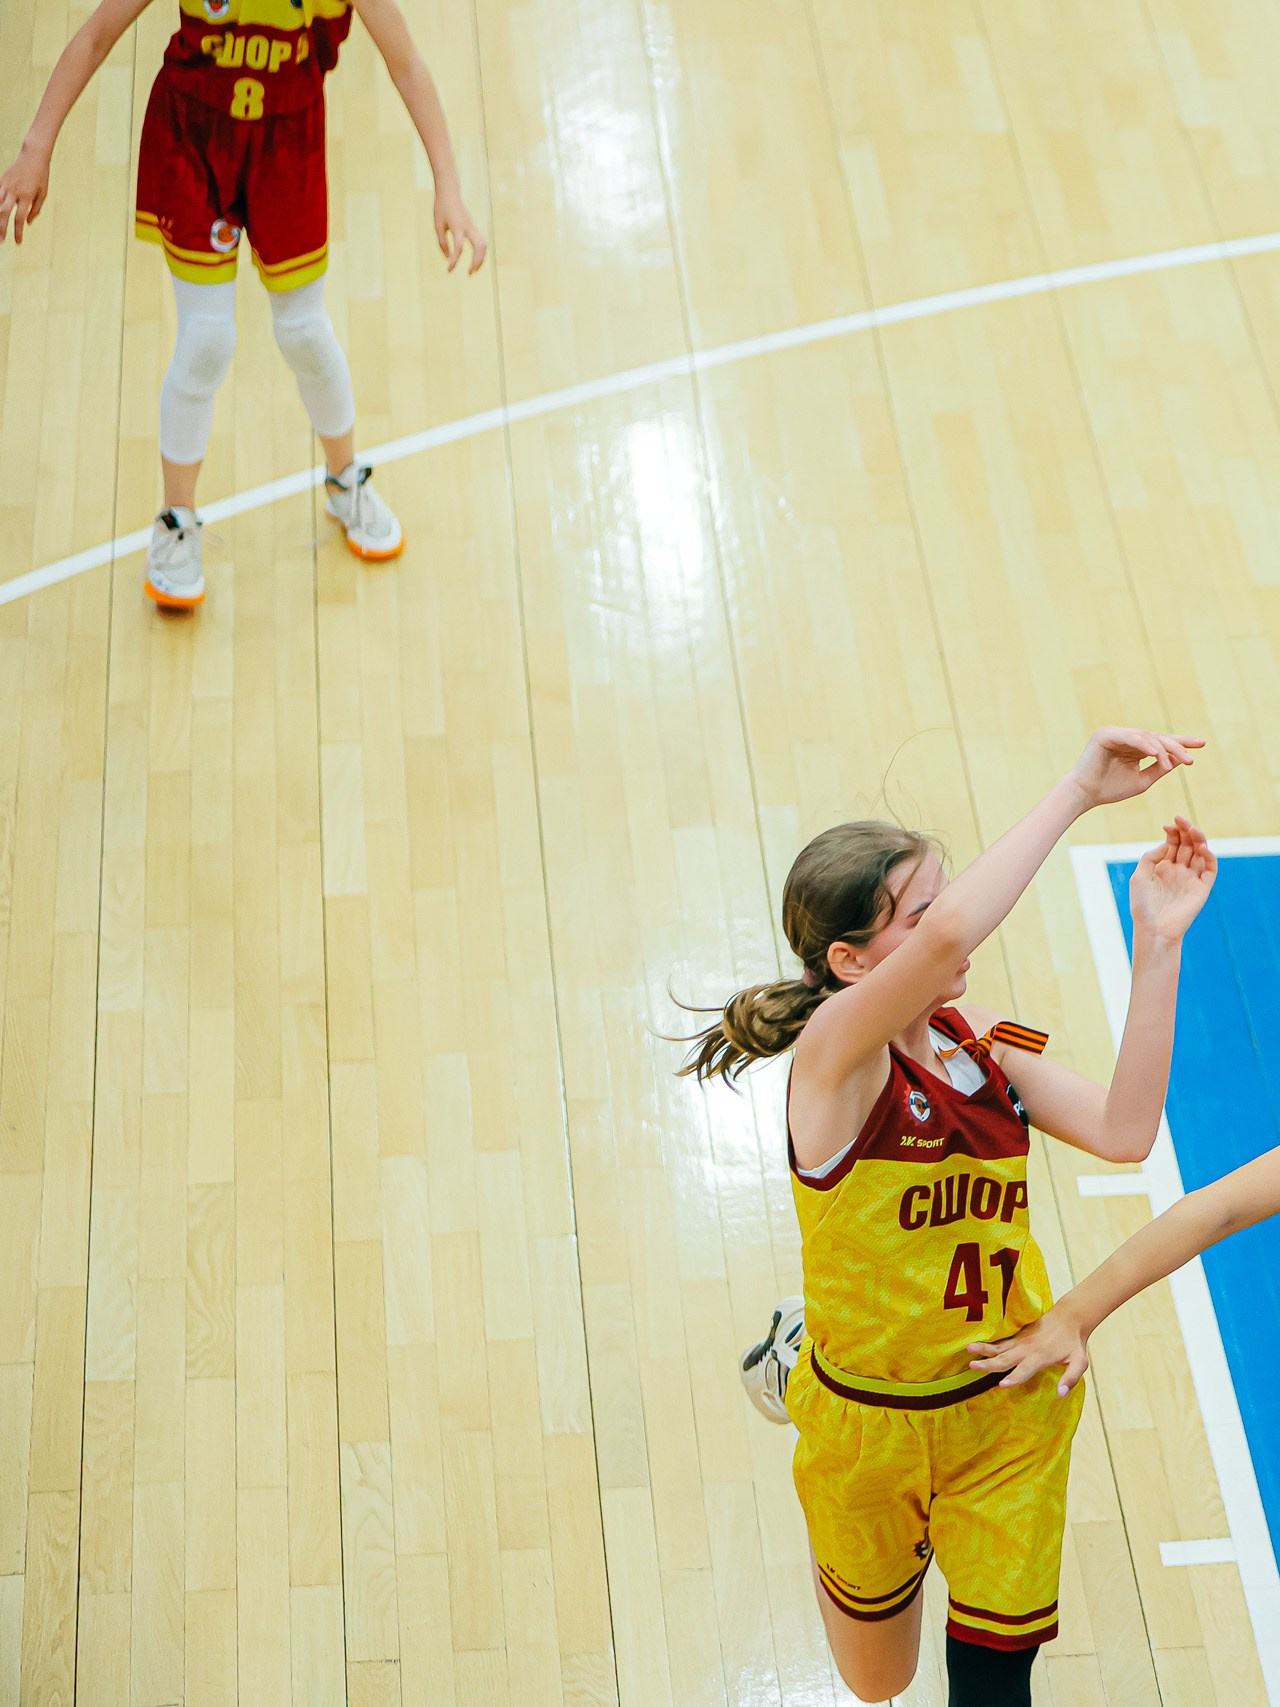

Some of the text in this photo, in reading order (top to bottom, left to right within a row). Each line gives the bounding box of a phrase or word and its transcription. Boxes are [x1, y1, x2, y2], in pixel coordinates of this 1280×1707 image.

[230, 77, 265, 120] 8
[917, 1138, 945, 1148] SPORT
[899, 1173, 1029, 1231] СШОР
[944, 1242, 1020, 1322] 41
